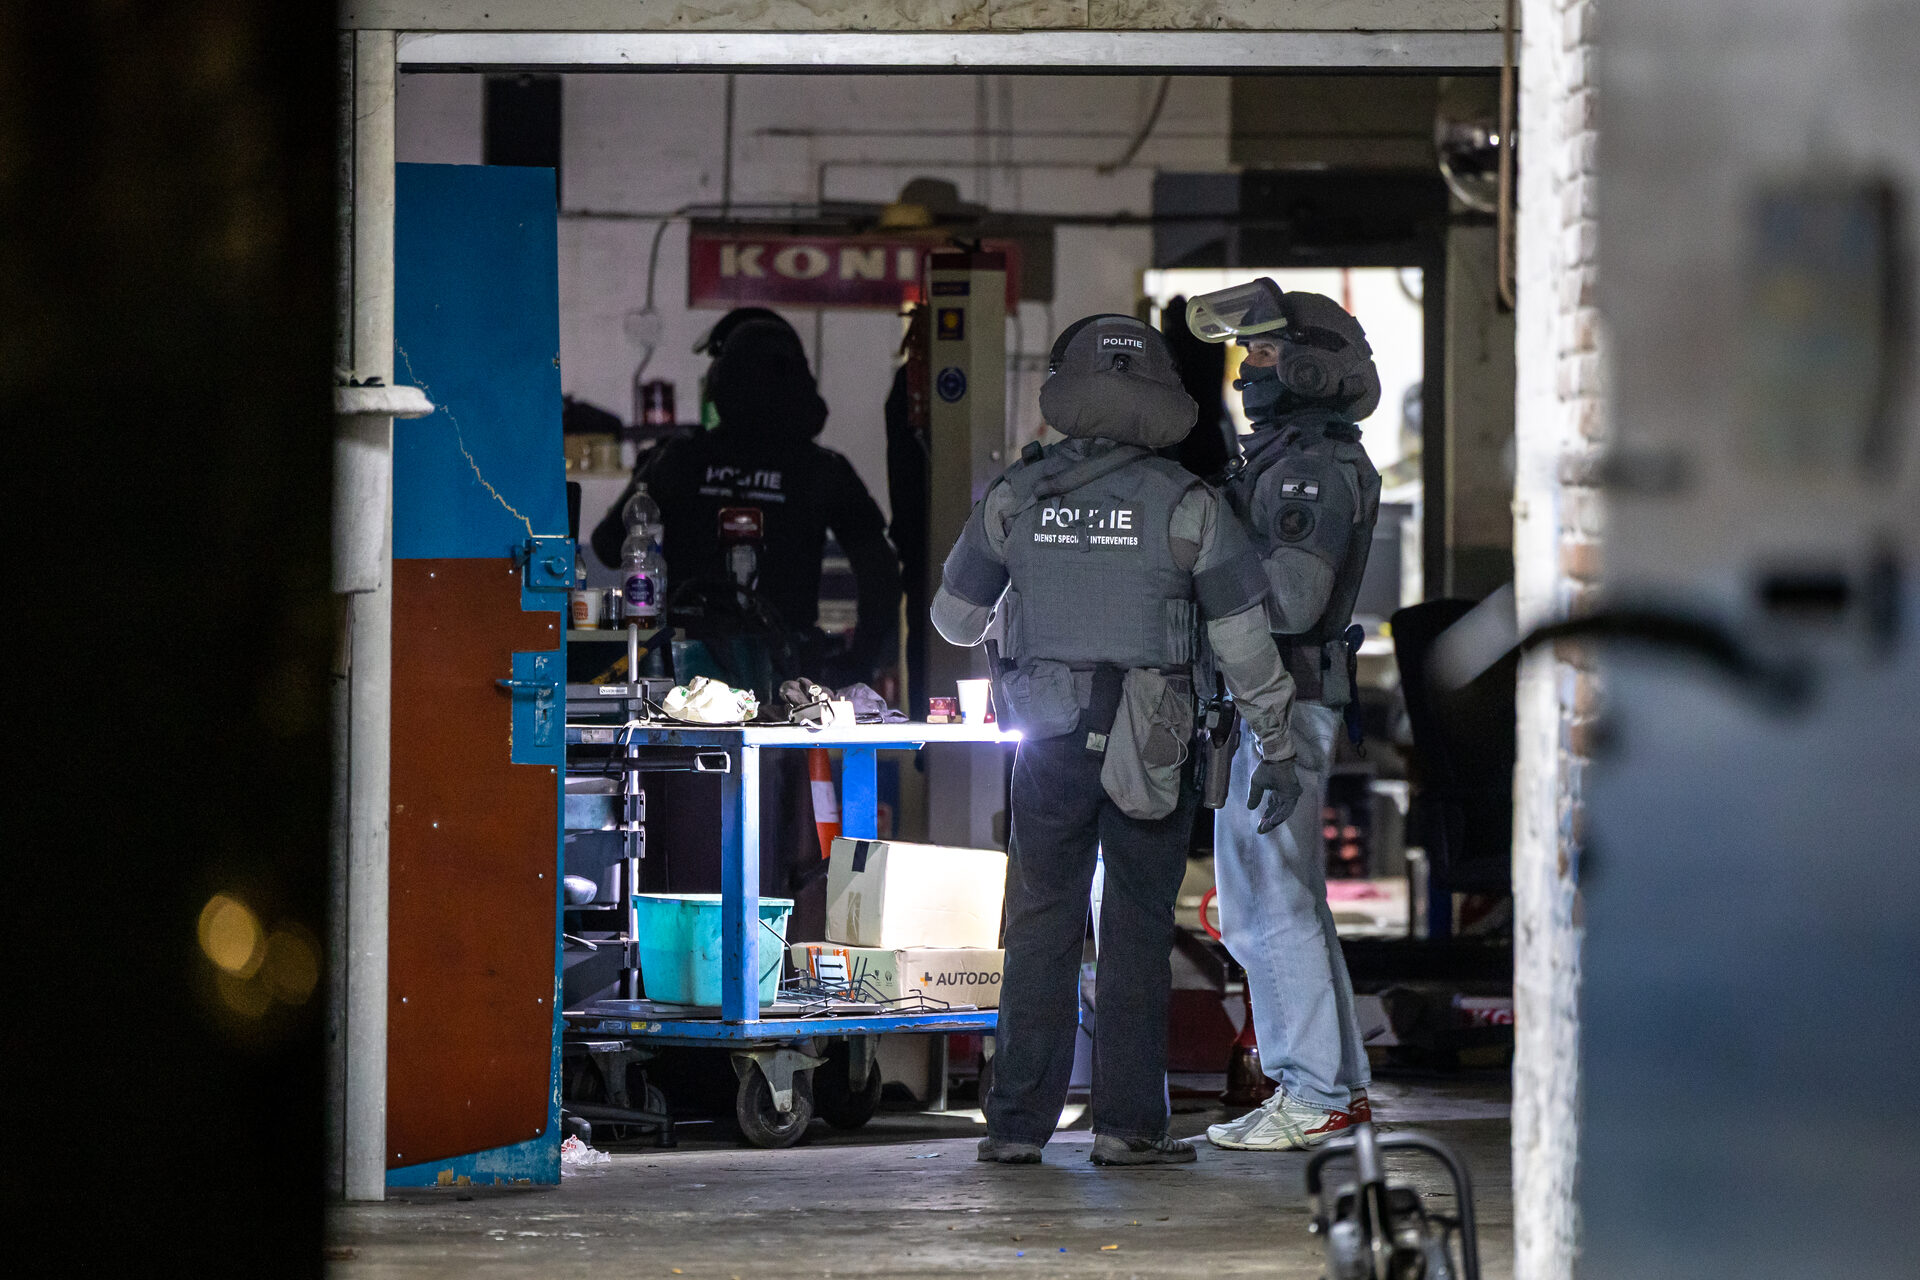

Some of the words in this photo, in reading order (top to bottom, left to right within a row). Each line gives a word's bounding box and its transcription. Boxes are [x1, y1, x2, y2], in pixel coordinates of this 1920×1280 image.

[720, 245, 916, 280] KONI
[1103, 338, 1143, 348] POLITIE
[1034, 533, 1057, 543] DIENST
[1057, 535, 1089, 544] SPECI
[1090, 535, 1138, 546] INTERVENTIES
[936, 971, 1003, 986] AUTODO
